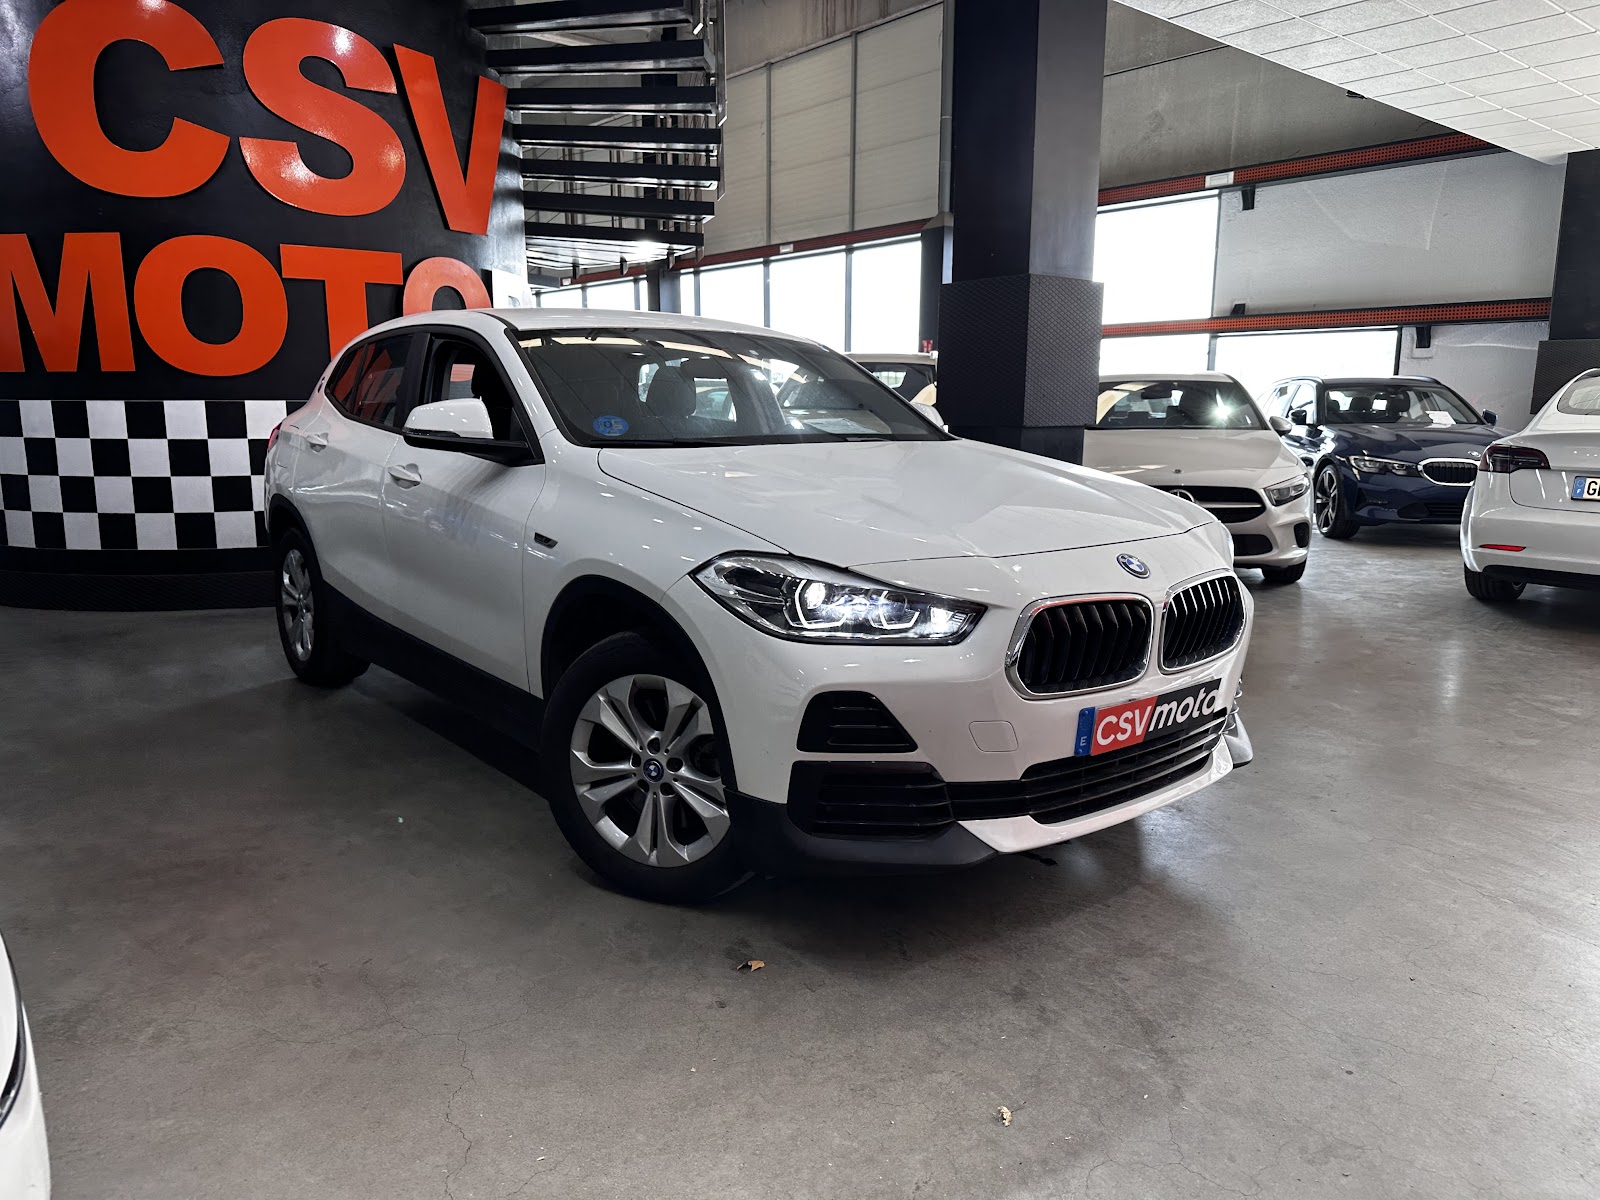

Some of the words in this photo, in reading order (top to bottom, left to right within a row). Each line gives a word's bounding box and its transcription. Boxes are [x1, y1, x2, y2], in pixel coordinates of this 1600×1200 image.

[28, 0, 508, 235] CSV
[1586, 480, 1600, 496] G
[1080, 736, 1087, 746] E
